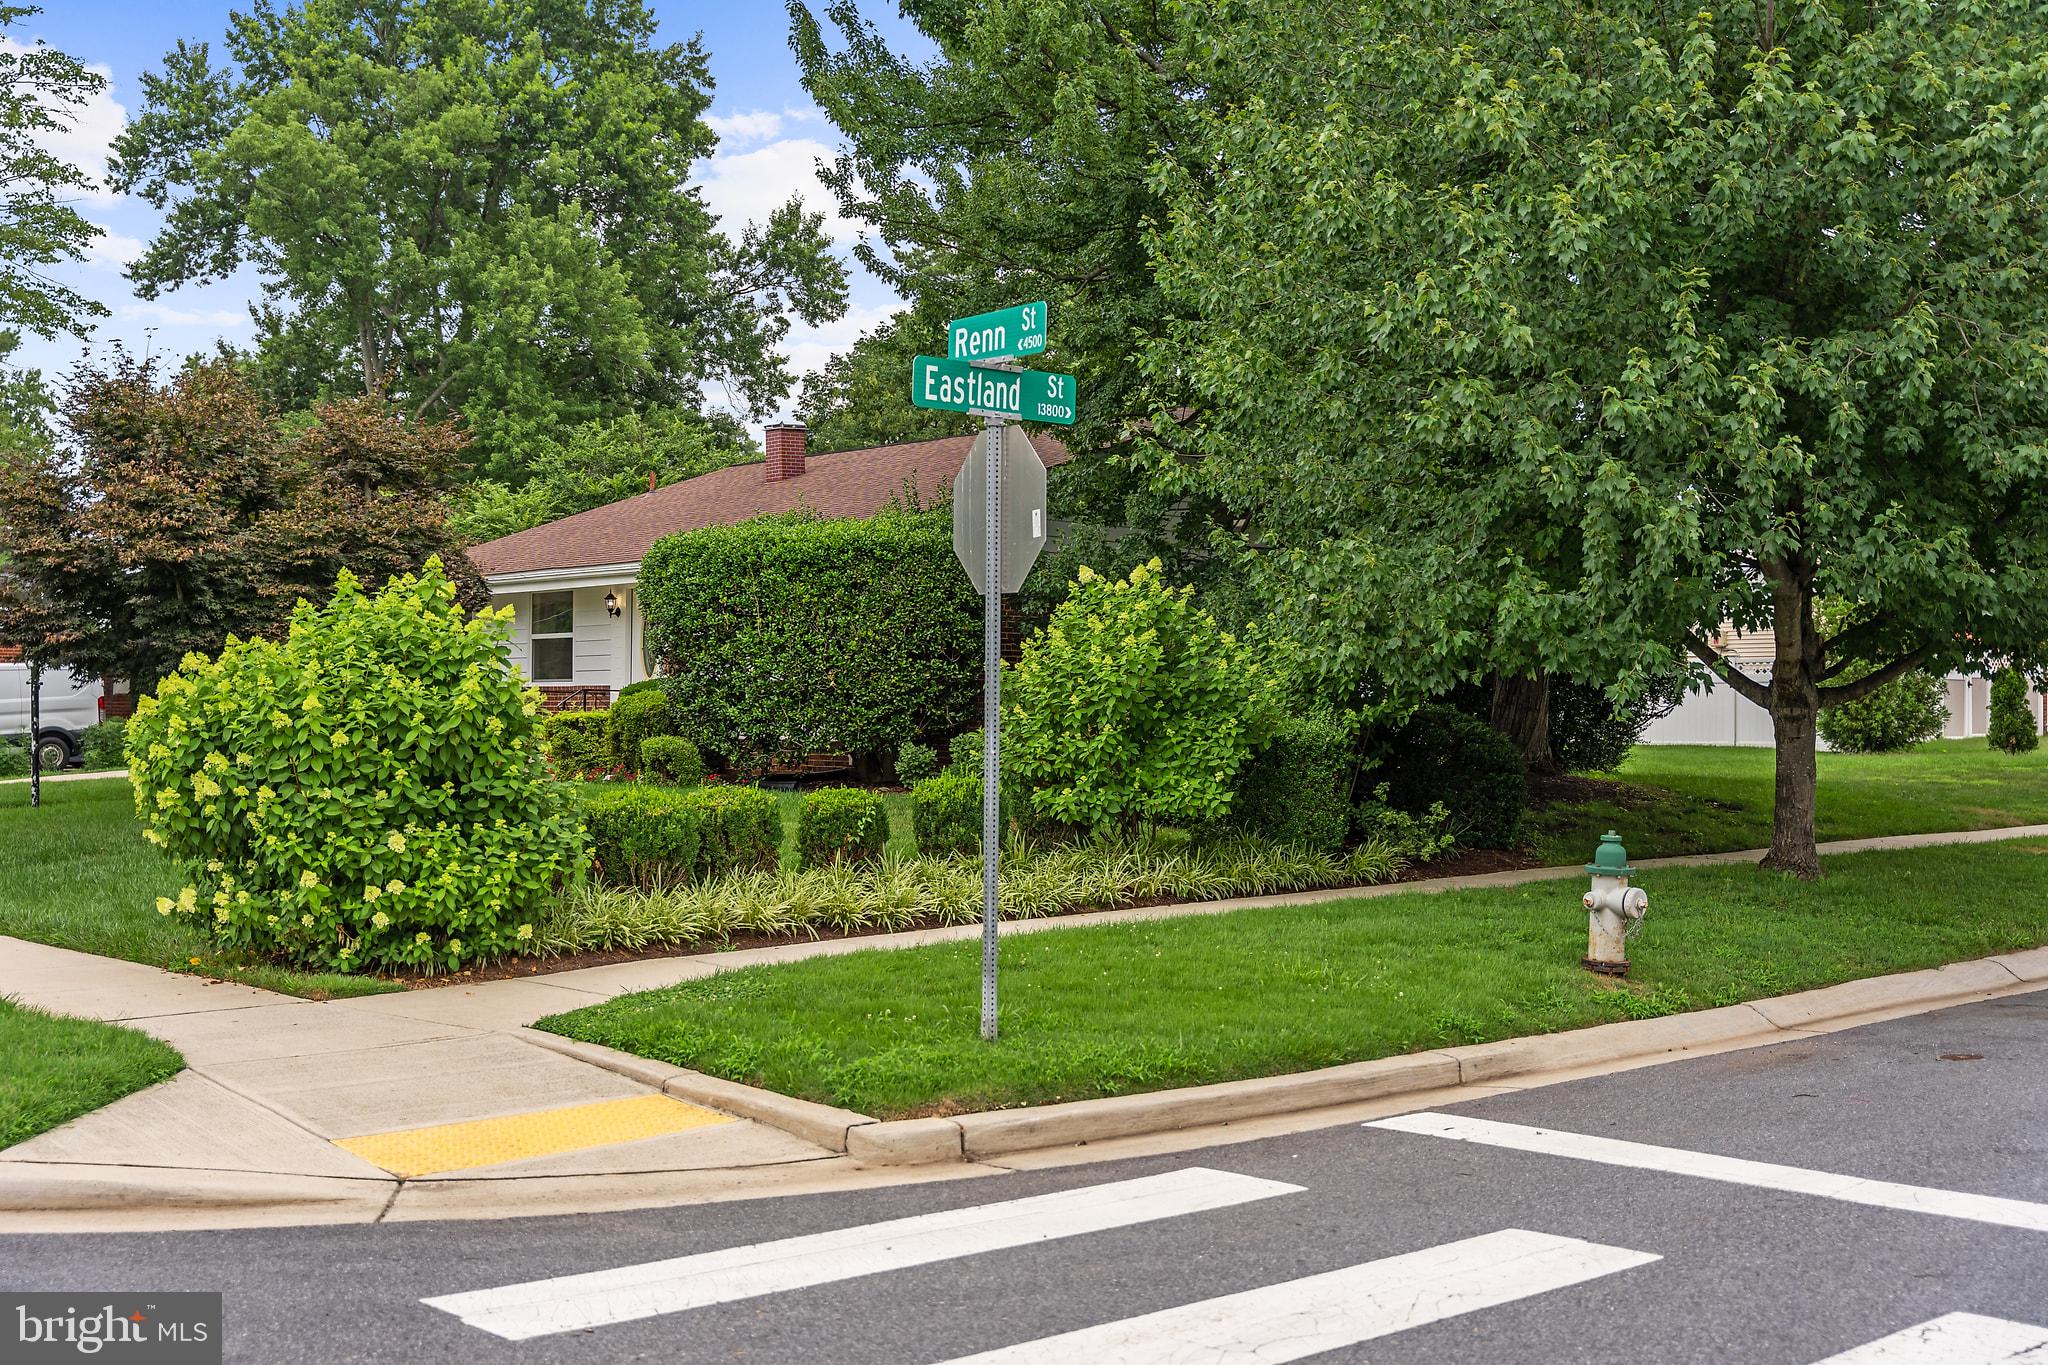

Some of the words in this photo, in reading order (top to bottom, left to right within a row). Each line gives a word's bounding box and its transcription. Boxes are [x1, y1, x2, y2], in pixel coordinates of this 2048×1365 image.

[955, 326, 1006, 358] Renn
[1021, 307, 1037, 331] St
[1023, 334, 1042, 350] 4500
[925, 364, 1020, 411] Eastland
[1047, 374, 1064, 399] St
[1037, 403, 1065, 418] 13800
